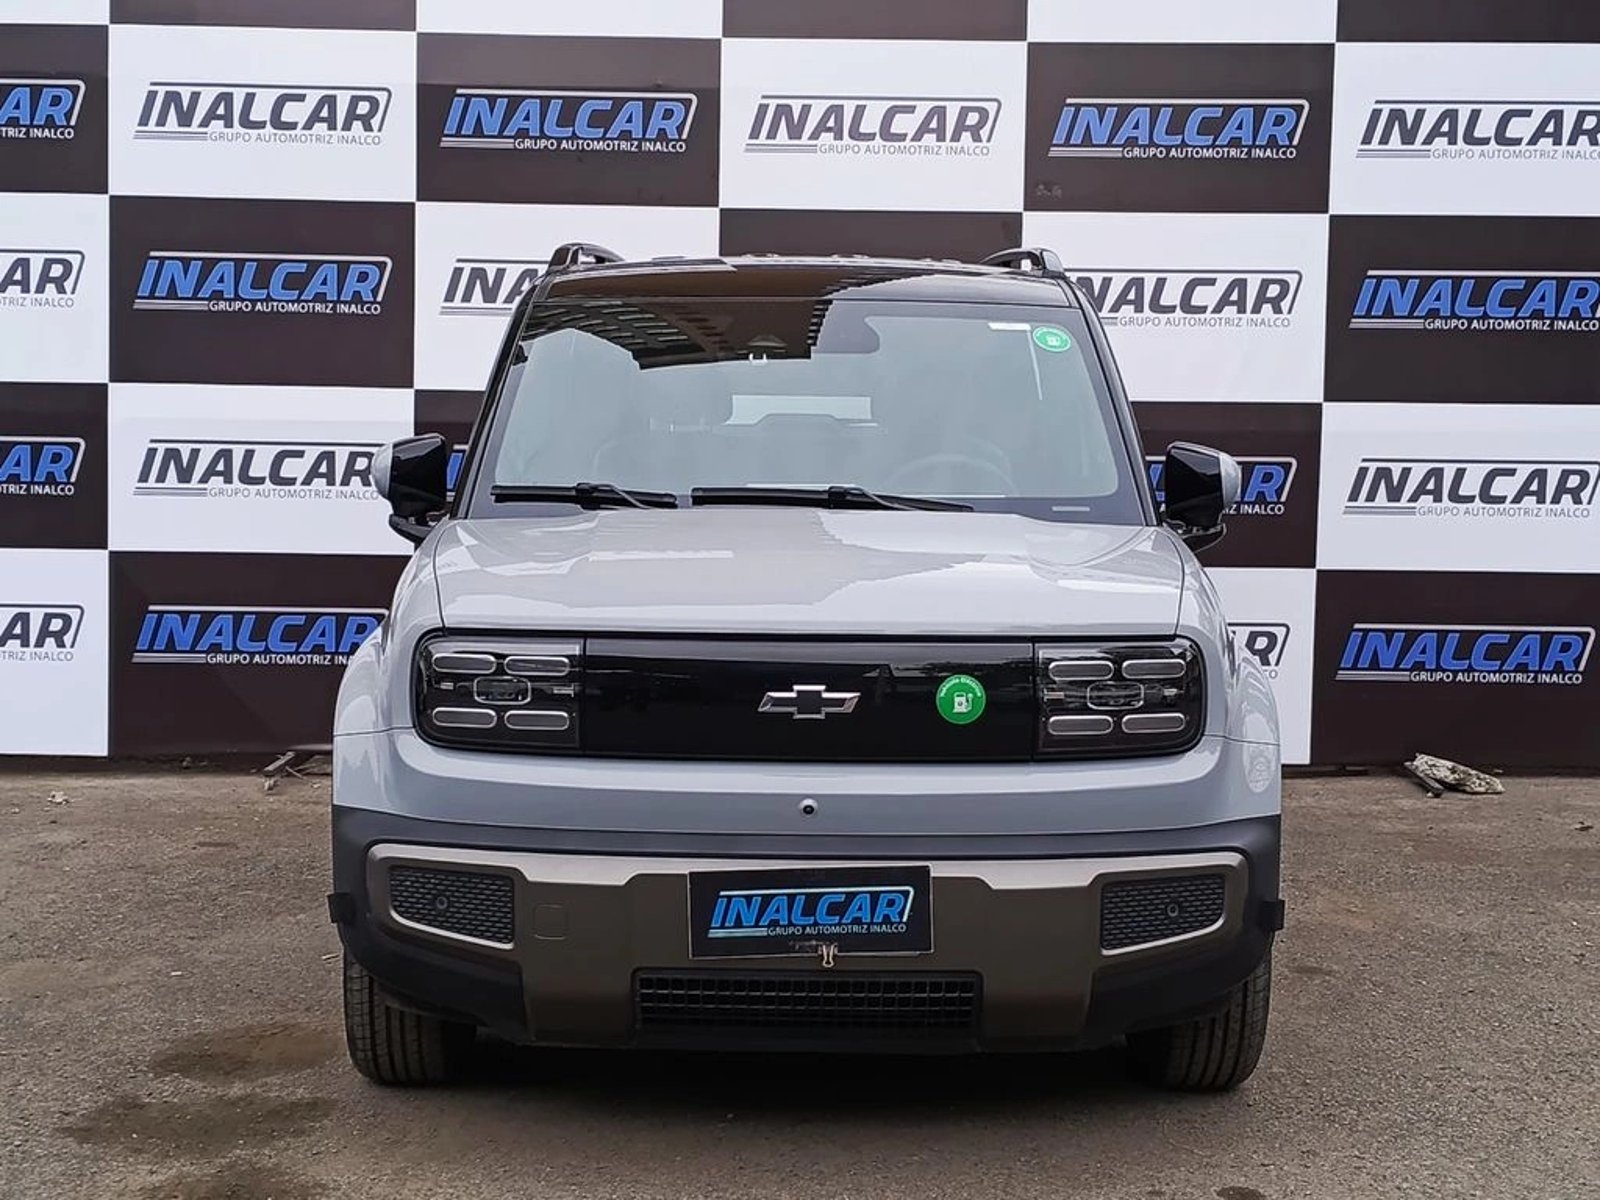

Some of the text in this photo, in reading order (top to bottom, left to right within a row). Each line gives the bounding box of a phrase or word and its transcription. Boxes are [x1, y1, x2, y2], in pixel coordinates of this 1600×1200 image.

[137, 89, 380, 132] INALCAR
[443, 96, 686, 139] INALCAR
[748, 103, 989, 143] INALCAR
[1052, 106, 1297, 146] INALCAR
[1360, 108, 1600, 146] INALCAR
[29, 127, 74, 139] INALCO
[209, 131, 381, 146] GRUPO AUTOMOTRIZ INALCO
[515, 138, 686, 152] GRUPO AUTOMOTRIZ INALCO
[819, 143, 990, 156] GRUPO AUTOMOTRIZ INALCO
[1124, 147, 1296, 159] GRUPO AUTOMOTRIZ INALCO
[1432, 149, 1475, 159] GRUPO
[1478, 149, 1558, 160] AUTOMOTRIZ
[137, 259, 380, 302] INALCAR
[0, 296, 74, 308] TRIZ INALCO
[1075, 276, 1290, 315] NALCAR
[1353, 278, 1600, 318] INALCAR
[209, 300, 381, 315] GRUPO AUTOMOTRIZ INALCO
[1119, 316, 1291, 328] GRUPO AUTOMOTRIZ INALCO
[1424, 318, 1599, 331] GRUPO AUTOMOTRIZ INALCO
[137, 447, 375, 488] INALCAR
[0, 484, 75, 496] TRIZ INALCO
[1346, 466, 1591, 506] INALCAR
[209, 487, 379, 501] GRUPO AUTOMOTRIZ INALCO
[1240, 504, 1285, 515] INALCO
[1418, 506, 1590, 518] GRUPO AUTOMOTRIZ INALCO
[29, 650, 74, 662] INALCO
[1340, 631, 1584, 672] INALCAR
[207, 653, 249, 664] GRUPO
[252, 654, 331, 665] AUTOMOTRIZ
[1410, 671, 1583, 685] GRUPO AUTOMOTRIZ INALCO
[711, 893, 906, 927] INALCAR
[768, 924, 907, 936] GRUPO AUTOMOTRIZ INALCO
